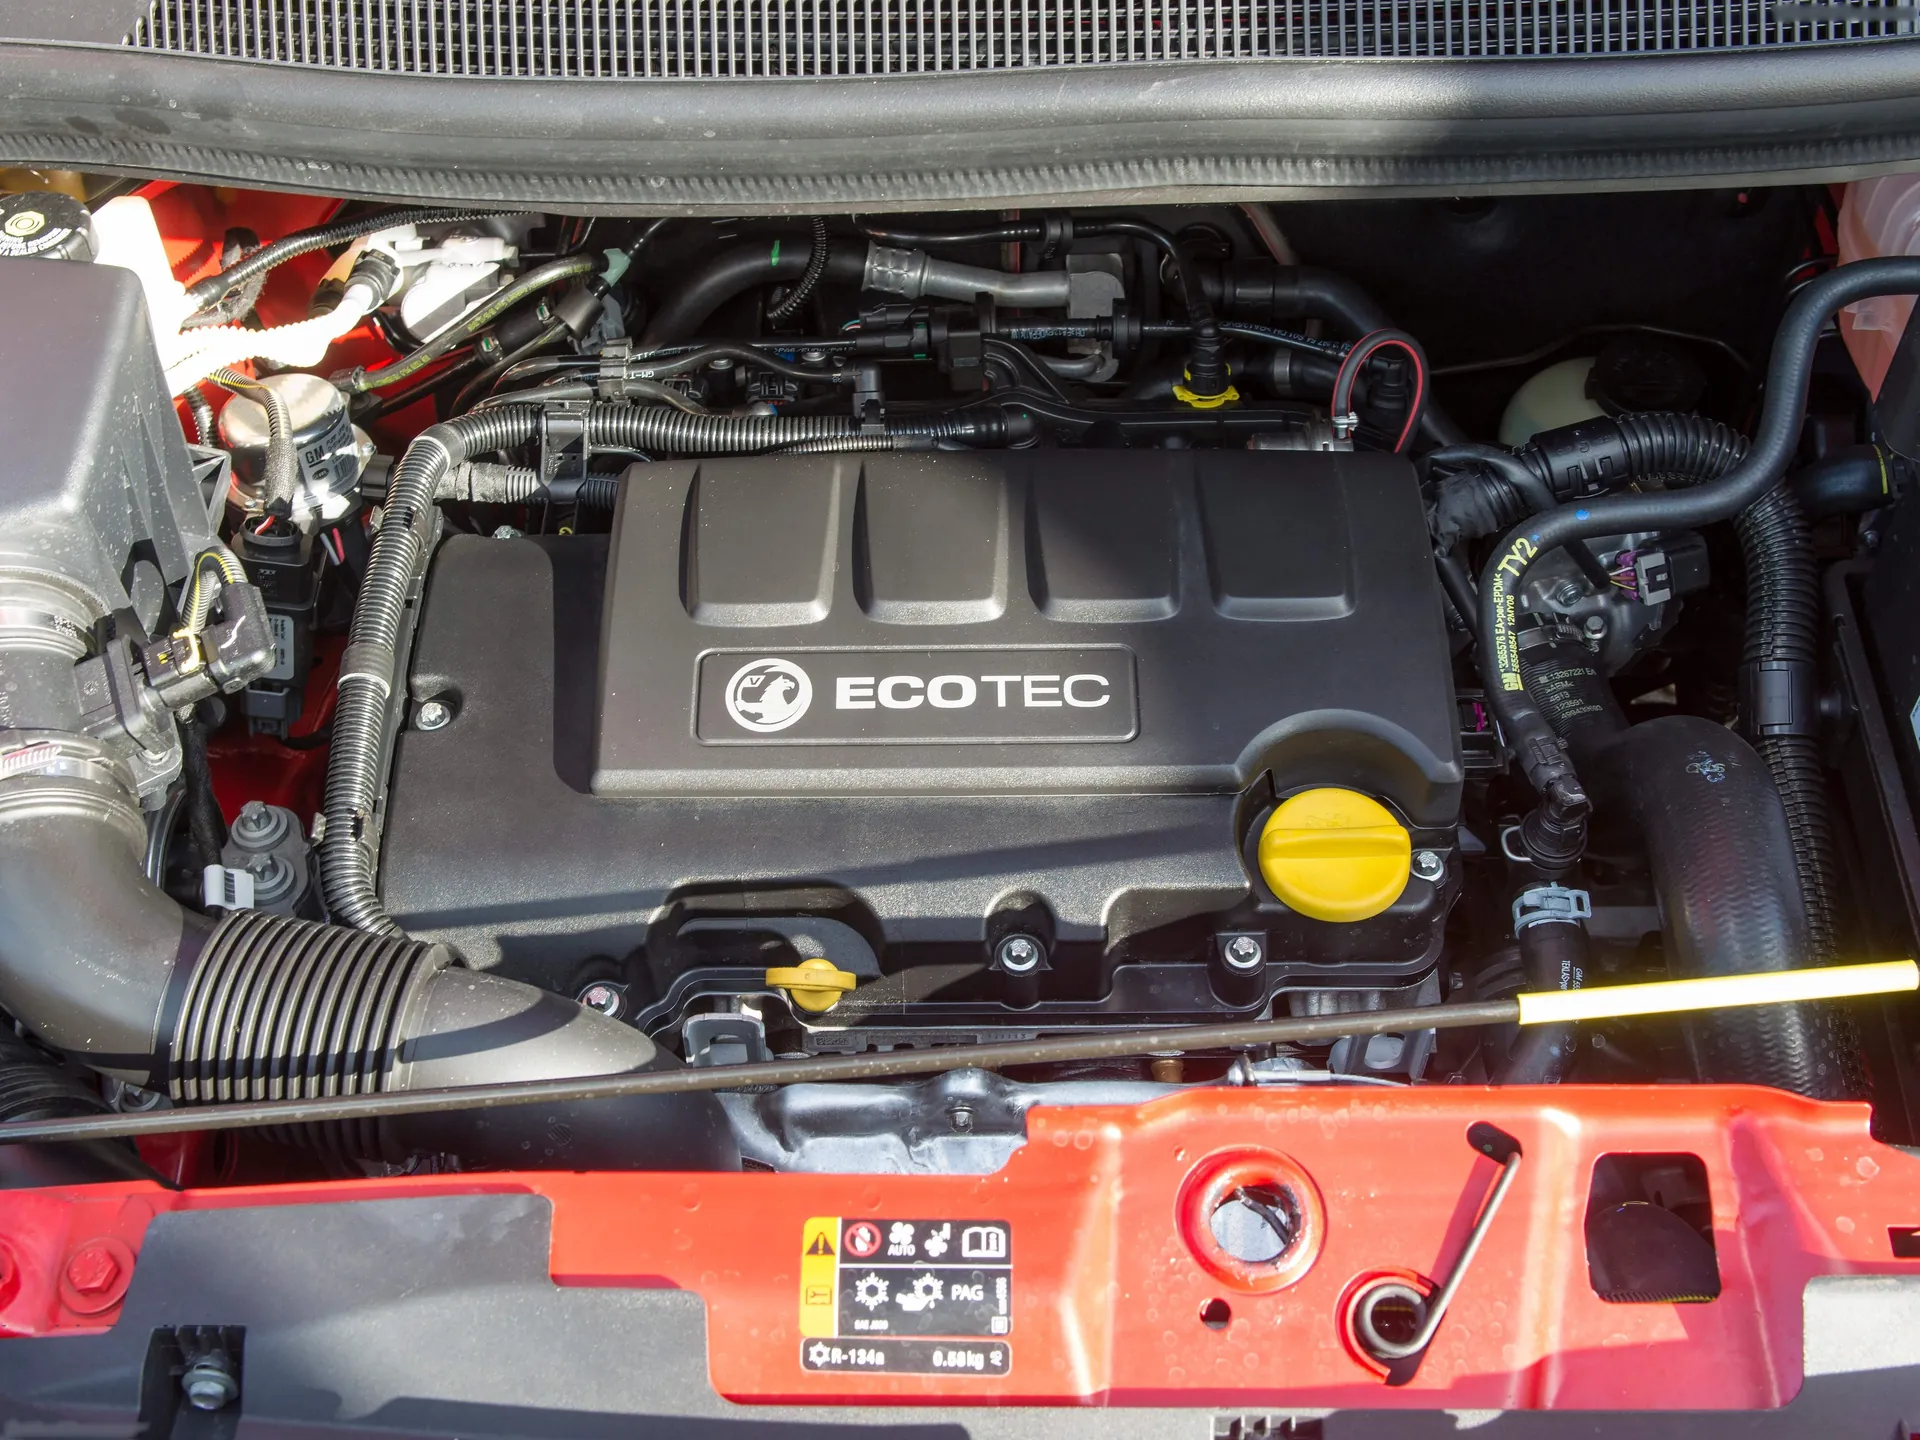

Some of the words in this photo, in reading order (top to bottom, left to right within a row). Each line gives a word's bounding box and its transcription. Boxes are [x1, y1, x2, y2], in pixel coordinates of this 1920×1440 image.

[305, 444, 325, 465] GM
[1497, 537, 1539, 577] TY2
[835, 674, 1111, 710] ECOTEC
[1501, 672, 1520, 692] GM
[887, 1244, 916, 1257] AUTO
[951, 1285, 984, 1302] PAG
[830, 1347, 885, 1366] R-134a
